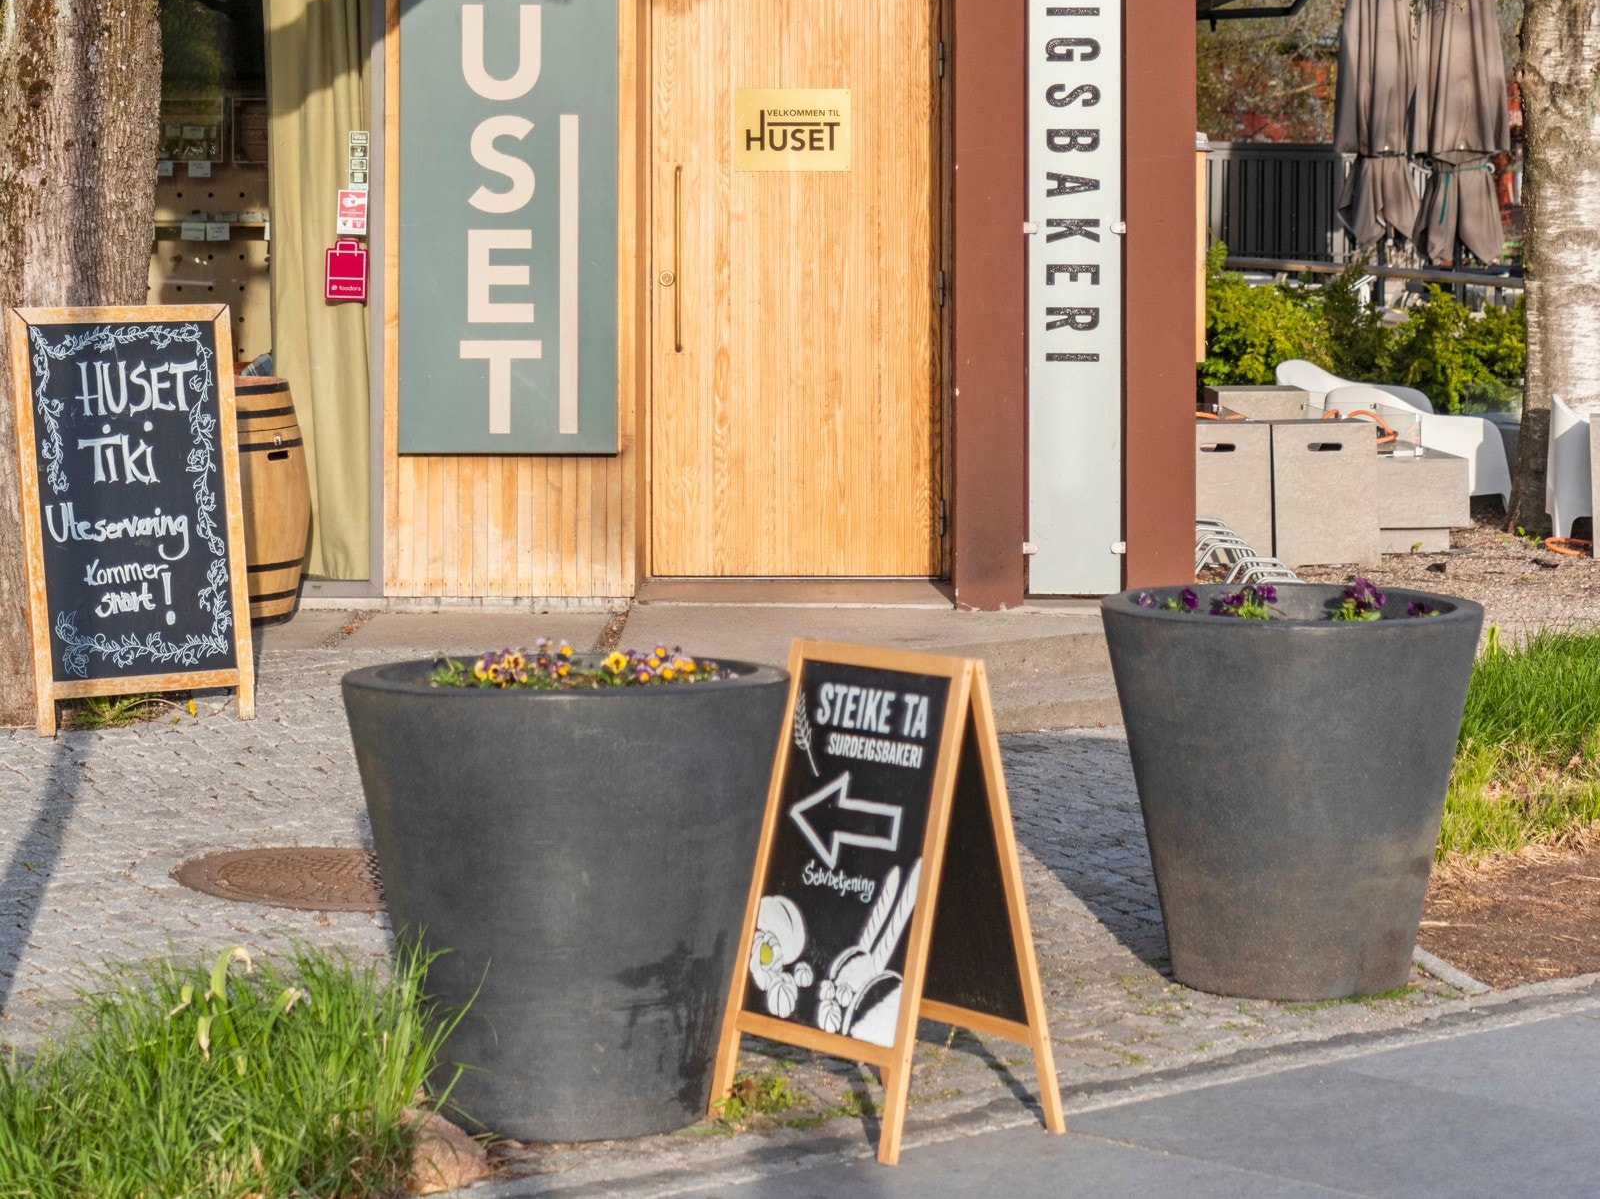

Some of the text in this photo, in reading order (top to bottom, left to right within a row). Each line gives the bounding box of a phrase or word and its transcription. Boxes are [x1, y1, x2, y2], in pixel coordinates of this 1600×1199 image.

[745, 109, 841, 151] HUSET
[767, 109, 840, 117] VELKOMMEN TIL
[338, 284, 362, 292] foodora
[75, 359, 198, 417] HUSET
[44, 502, 190, 561] Uteservering
[816, 682, 929, 739] STEIKE TA
[827, 732, 924, 770] SURDEIGSBAKERI
